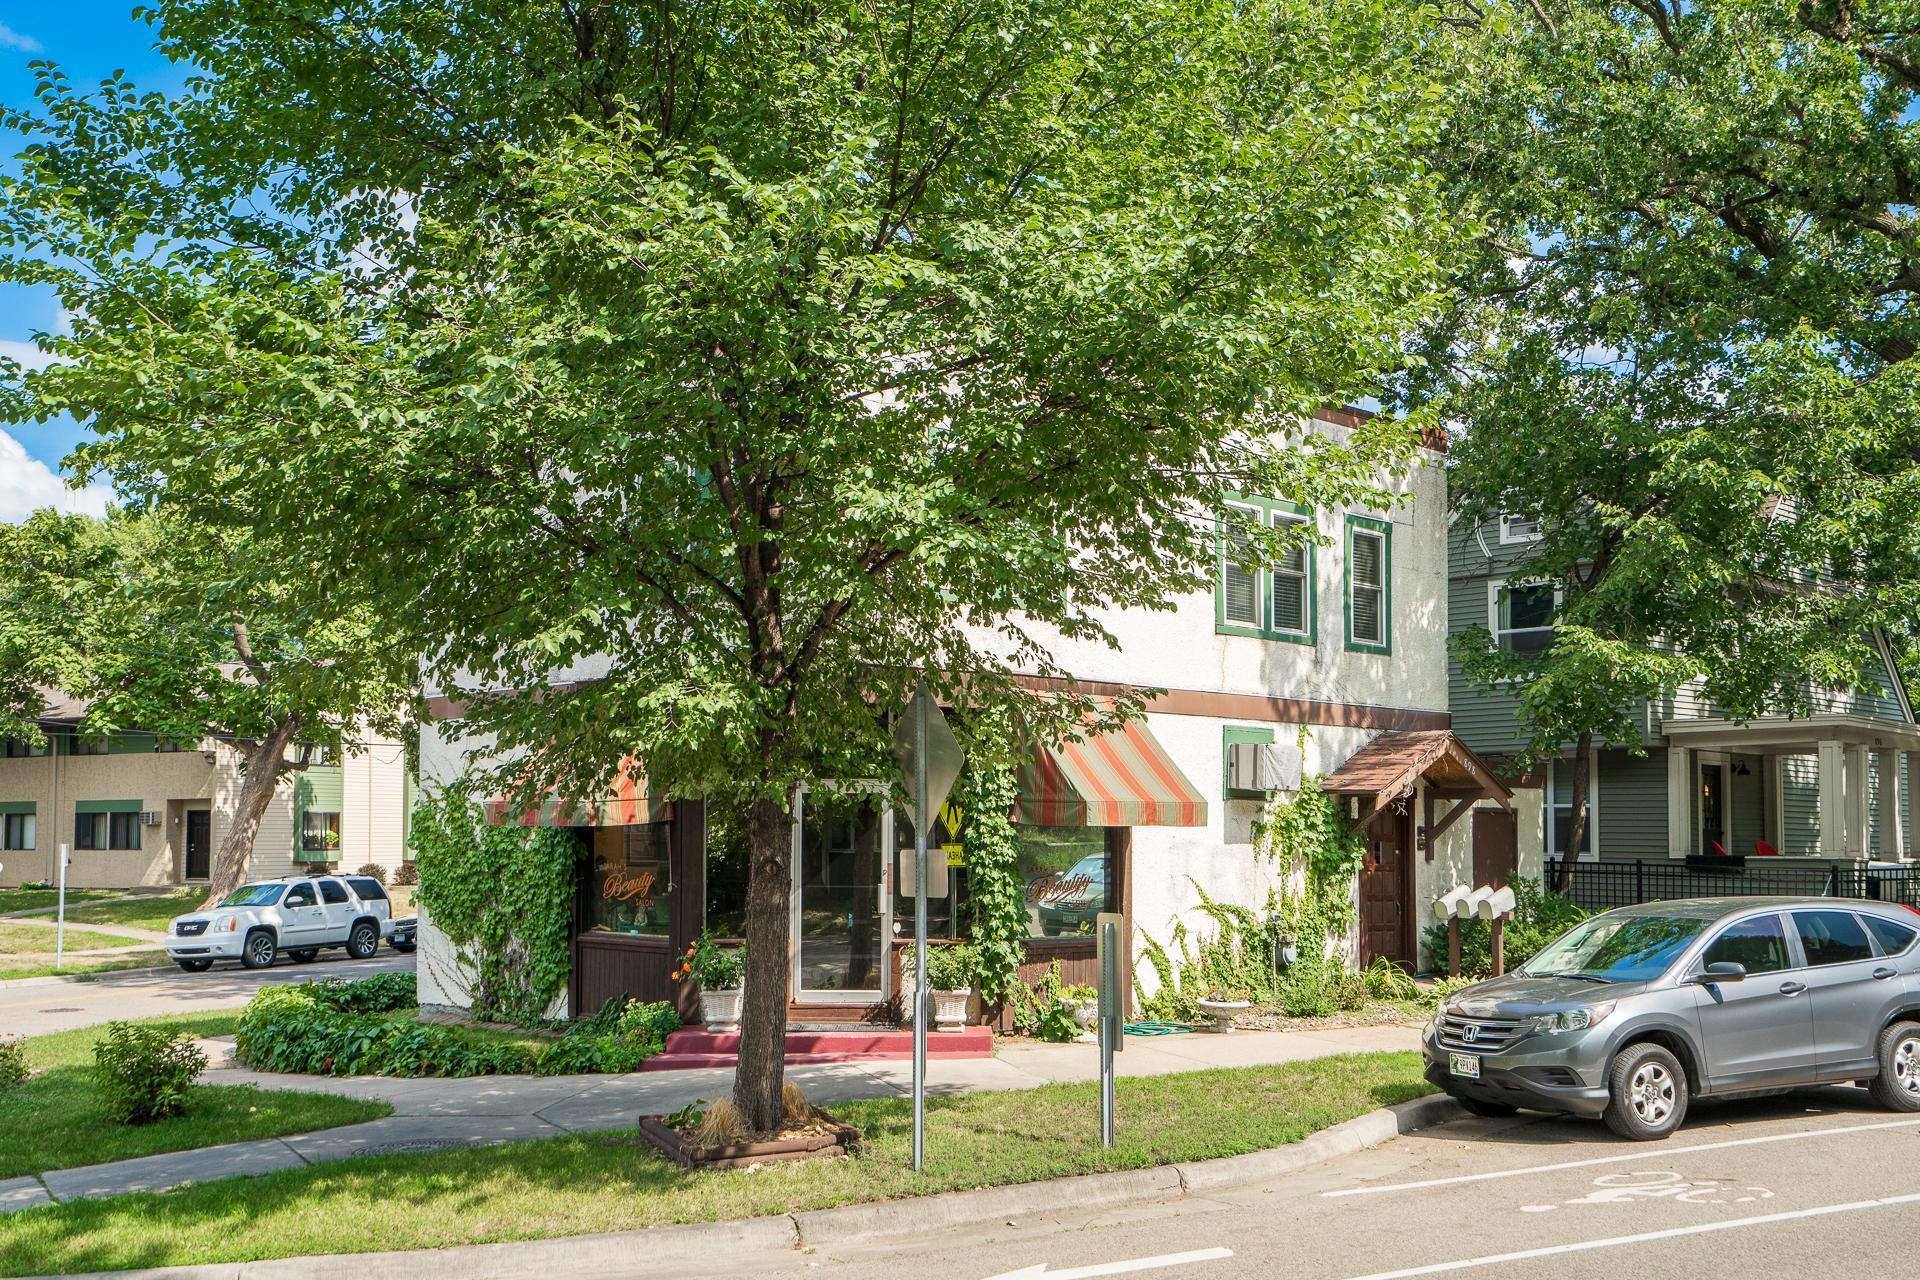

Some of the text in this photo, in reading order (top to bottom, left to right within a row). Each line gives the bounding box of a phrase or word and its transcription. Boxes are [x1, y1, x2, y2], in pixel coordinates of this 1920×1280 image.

[1463, 758, 1476, 775] 898
[603, 871, 656, 900] Beauty
[635, 899, 655, 907] SALON
